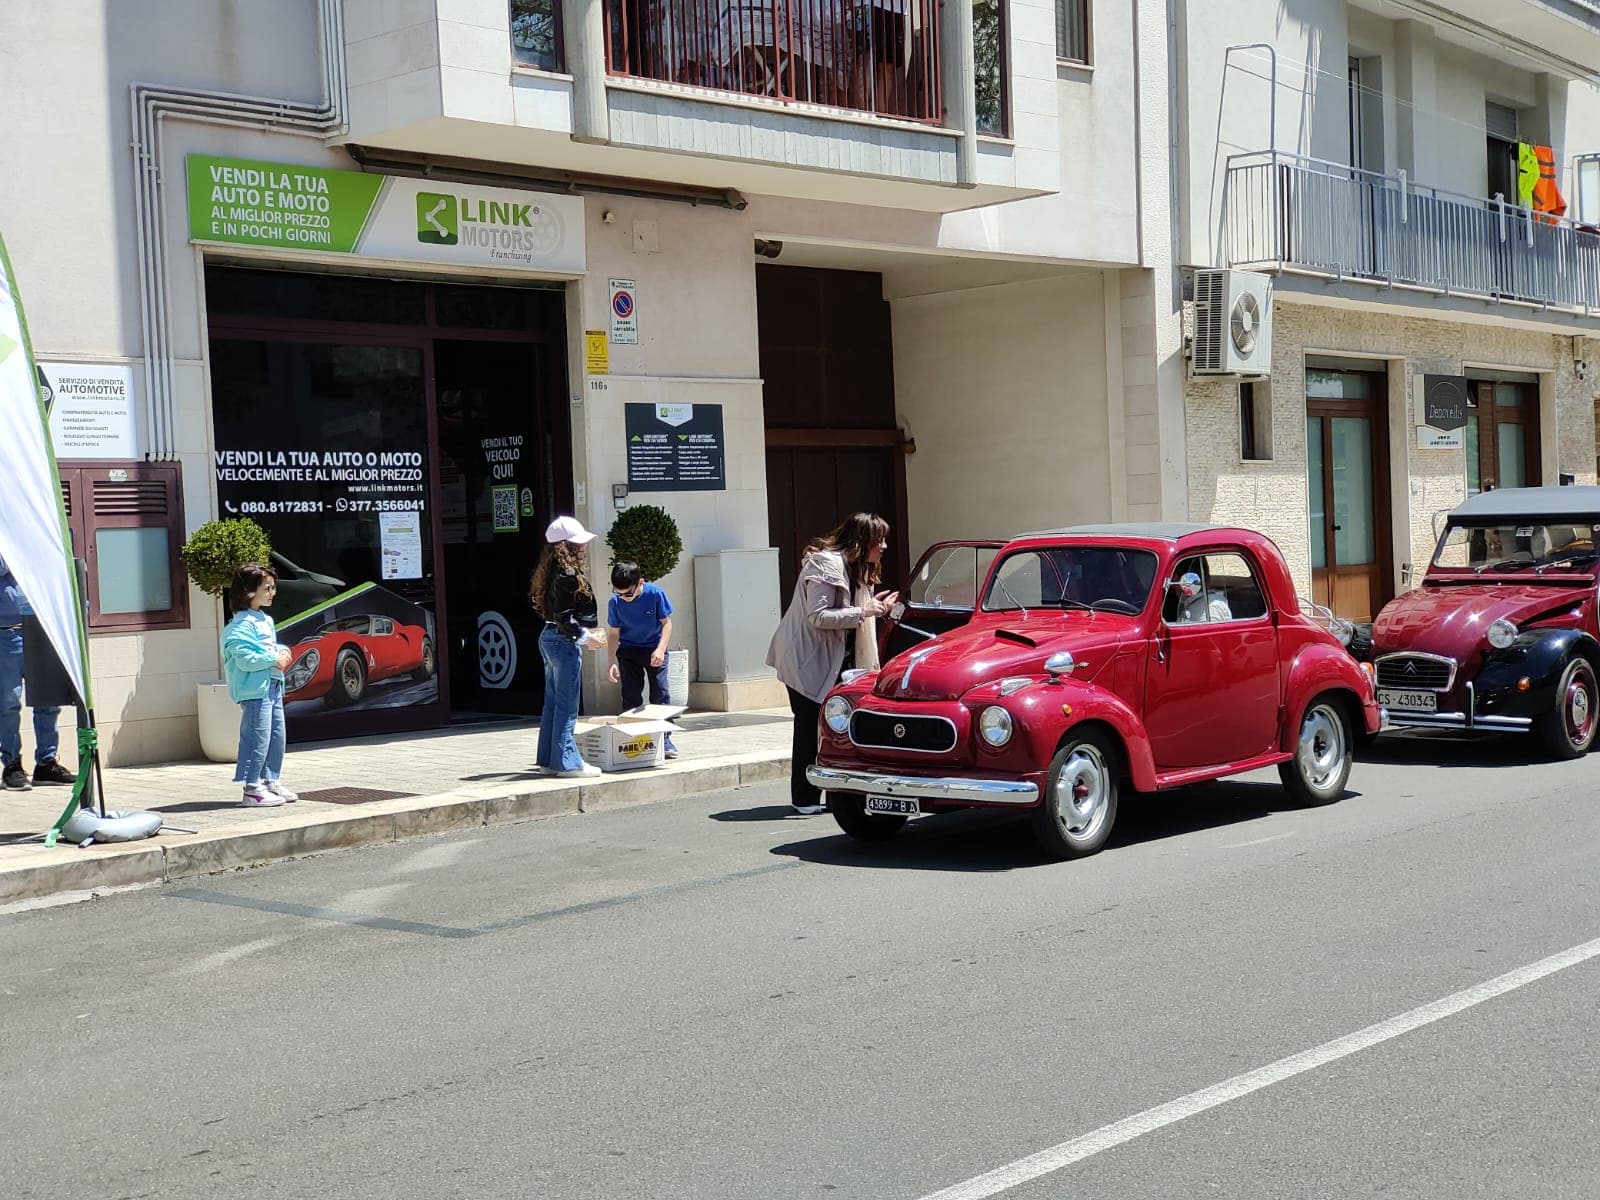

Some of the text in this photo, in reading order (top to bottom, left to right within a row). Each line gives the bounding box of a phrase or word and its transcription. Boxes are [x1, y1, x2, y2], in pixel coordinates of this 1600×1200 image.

[210, 165, 328, 193] VENDI LA TUA
[211, 185, 329, 212] AUTO E MOTO
[211, 206, 330, 228] AL MIGLIOR PREZZO
[212, 221, 331, 243] E IN POCHI GIORNI
[461, 226, 534, 251] MOTORS
[490, 249, 532, 263] Franchising
[58, 377, 88, 385] SERVIZIO
[59, 384, 125, 395] AUTOMOTIVE
[1429, 404, 1463, 419] Denovellis
[481, 438, 501, 448] VENDI
[509, 435, 523, 446] TUO
[216, 451, 422, 466] VENDI LA TUA AUTO O MOTO
[485, 448, 520, 462] VEICOLO
[217, 468, 422, 481] VELOCEMENTE E AL MIGLIOR PREZZO
[493, 463, 514, 479] QUI!
[348, 483, 423, 493] www.linkmotors.it
[241, 501, 323, 513] 080.8172831
[349, 500, 425, 511] 377.3566041
[1398, 694, 1436, 708] 430343
[869, 799, 893, 809] 43899
